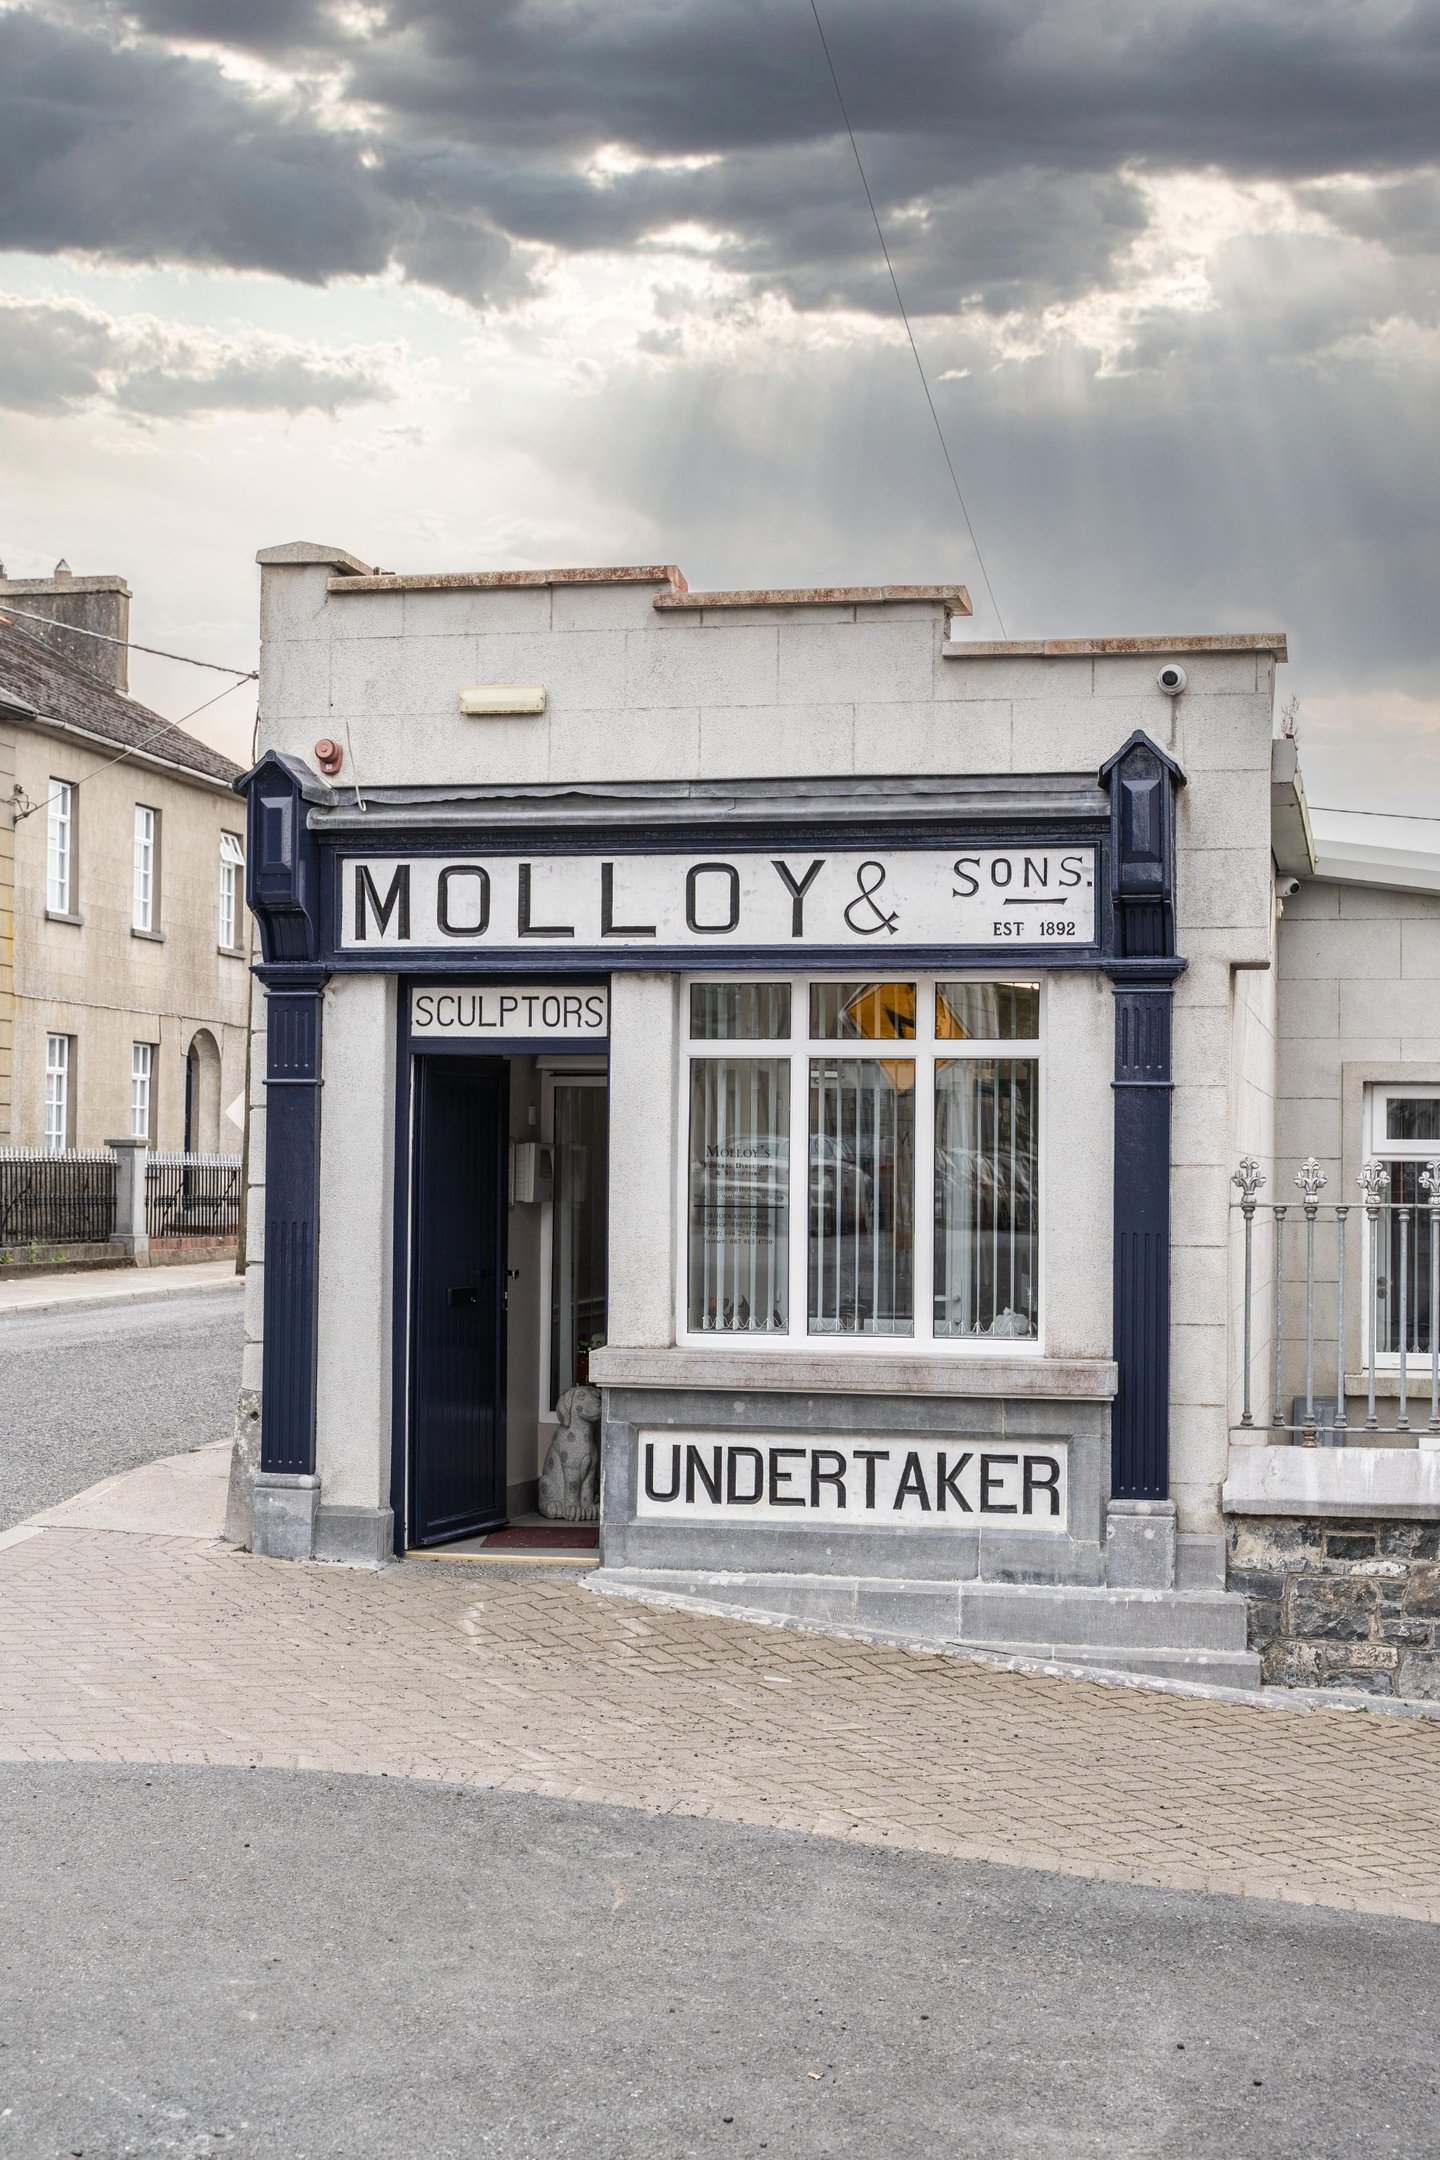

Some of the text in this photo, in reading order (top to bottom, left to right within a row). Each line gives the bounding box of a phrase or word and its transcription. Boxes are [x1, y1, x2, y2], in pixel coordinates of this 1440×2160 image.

[354, 859, 825, 941] MOLLOY
[843, 861, 900, 935] &
[1039, 922, 1076, 936] 1892
[415, 995, 604, 1028] SCULPTORS
[645, 1443, 1061, 1516] UNDERTAKER
